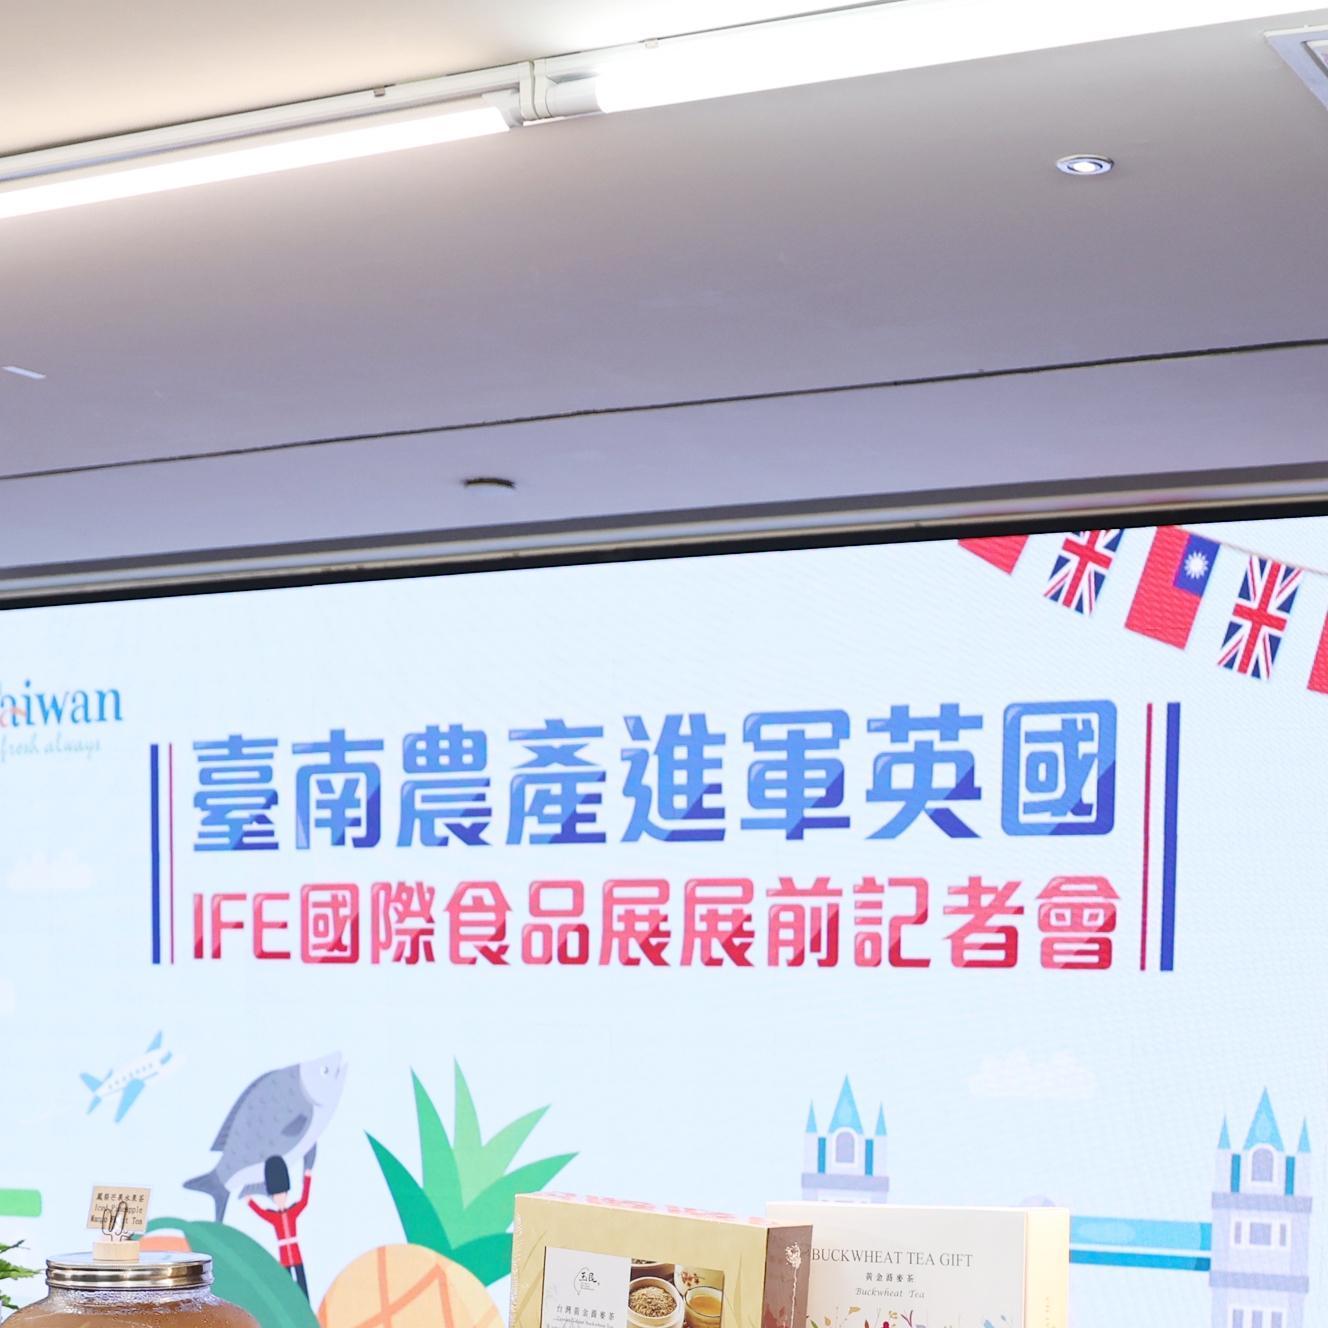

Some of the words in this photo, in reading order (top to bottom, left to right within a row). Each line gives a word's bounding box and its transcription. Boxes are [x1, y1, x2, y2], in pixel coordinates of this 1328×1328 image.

[0, 732, 40, 763] fresh
[192, 699, 1118, 851] 臺南農產進軍英國
[192, 875, 1120, 970] IFE國際食品展展前記者會
[812, 1248, 903, 1265] BUCKWHEAT
[907, 1251, 935, 1266] TEA
[939, 1252, 973, 1268] GIFT
[855, 1287, 903, 1298] Buckwheat
[908, 1289, 925, 1299] Tea
